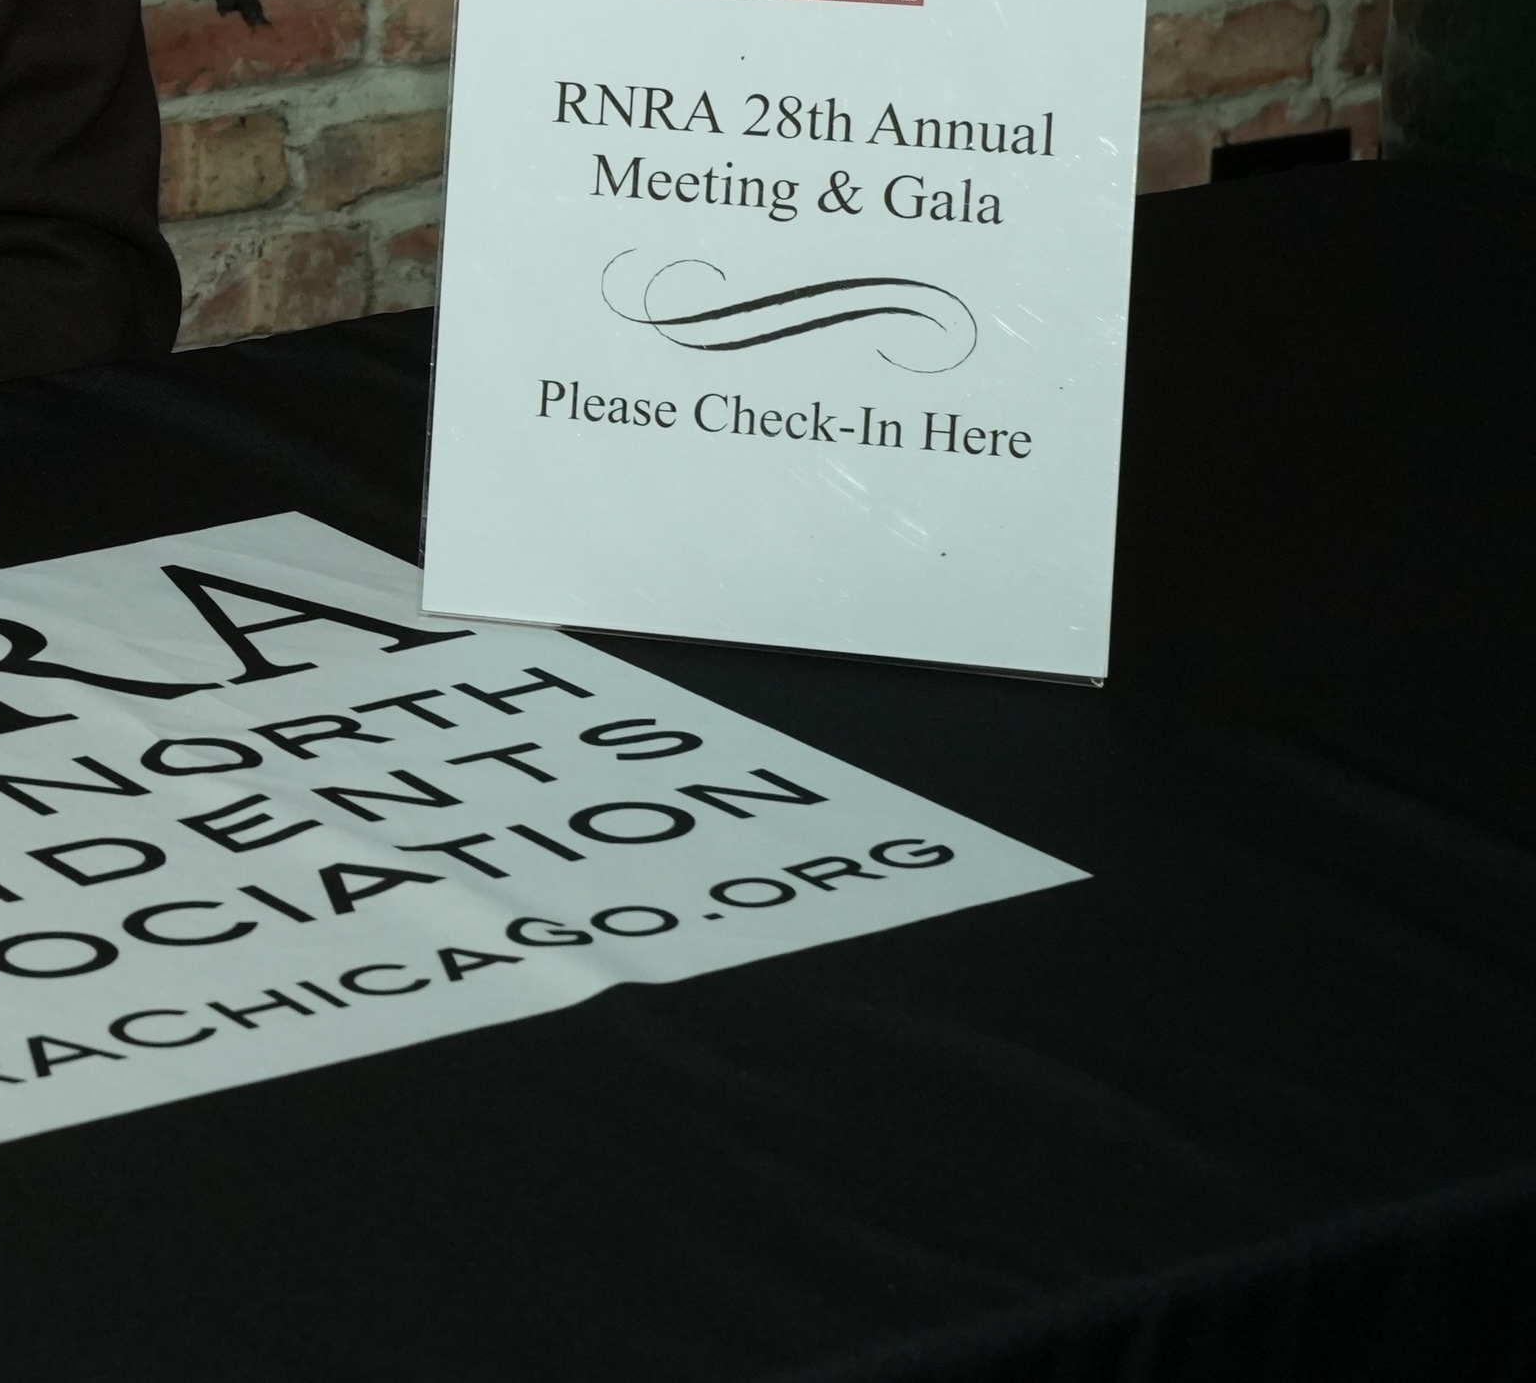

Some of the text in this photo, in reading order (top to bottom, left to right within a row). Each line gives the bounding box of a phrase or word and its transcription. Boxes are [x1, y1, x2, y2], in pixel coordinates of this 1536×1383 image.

[552, 81, 1054, 156] RNRA 28th Annual
[590, 154, 1004, 225] Meeting & Gala
[536, 380, 1033, 458] Please Check-In Here
